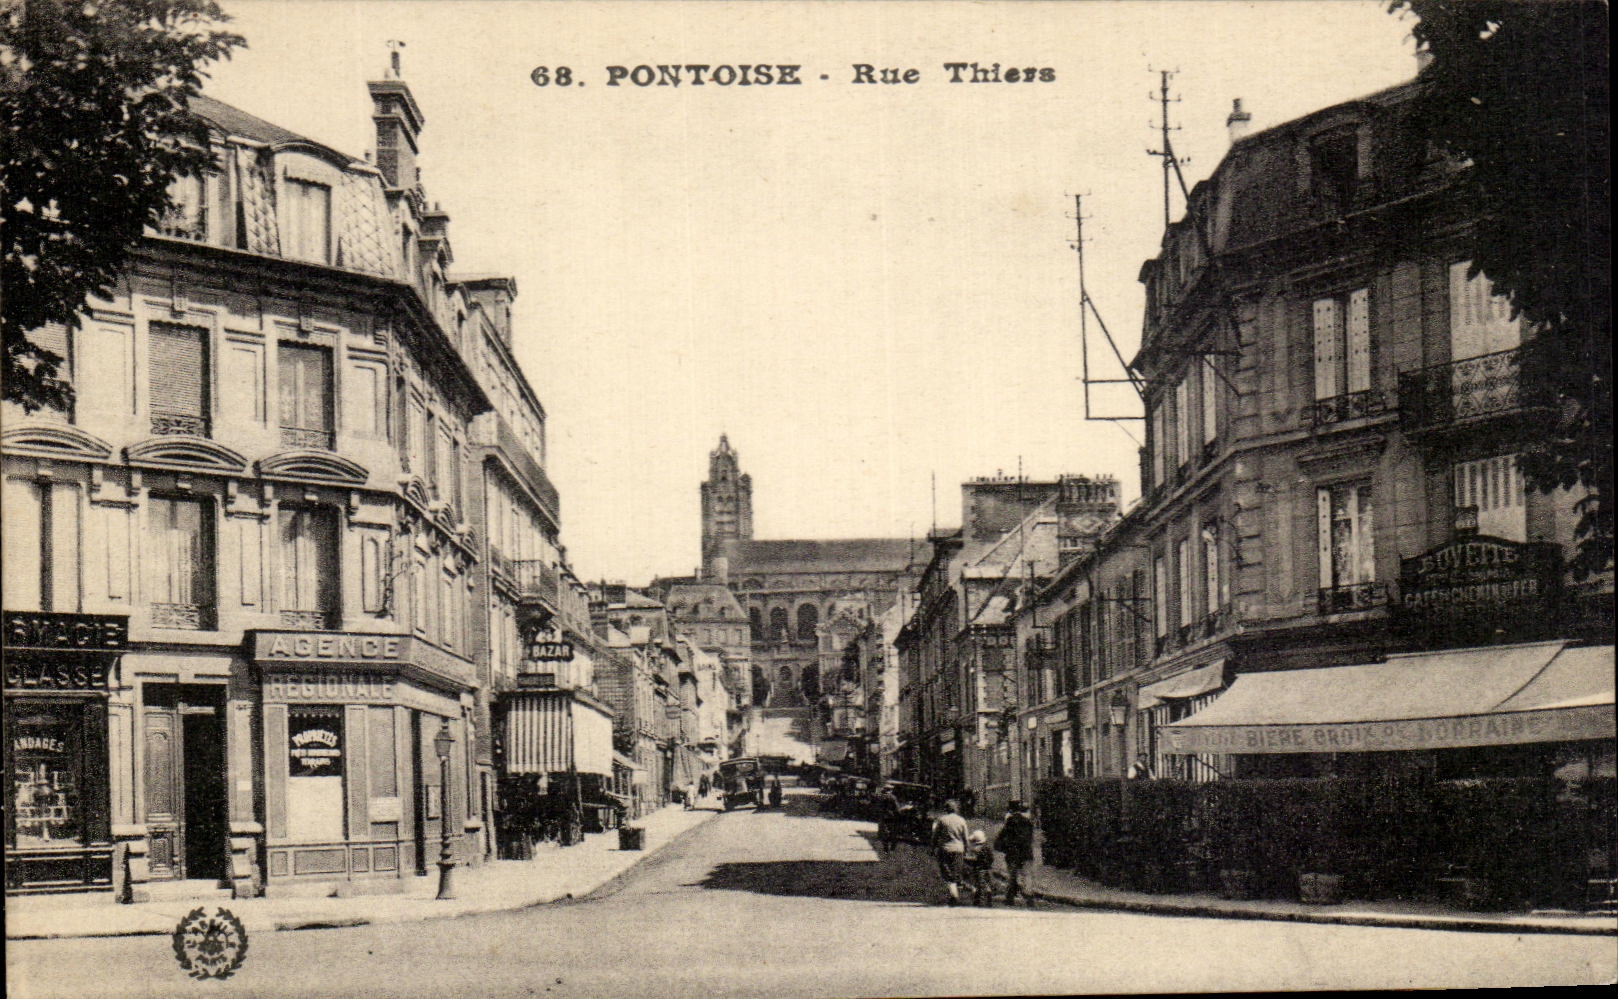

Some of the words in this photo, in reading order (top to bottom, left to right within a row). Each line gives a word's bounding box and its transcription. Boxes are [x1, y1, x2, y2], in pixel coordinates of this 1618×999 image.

[269, 635, 401, 659] AGENCE
[532, 644, 571, 658] BAZAR
[7, 664, 105, 687] CLASSE
